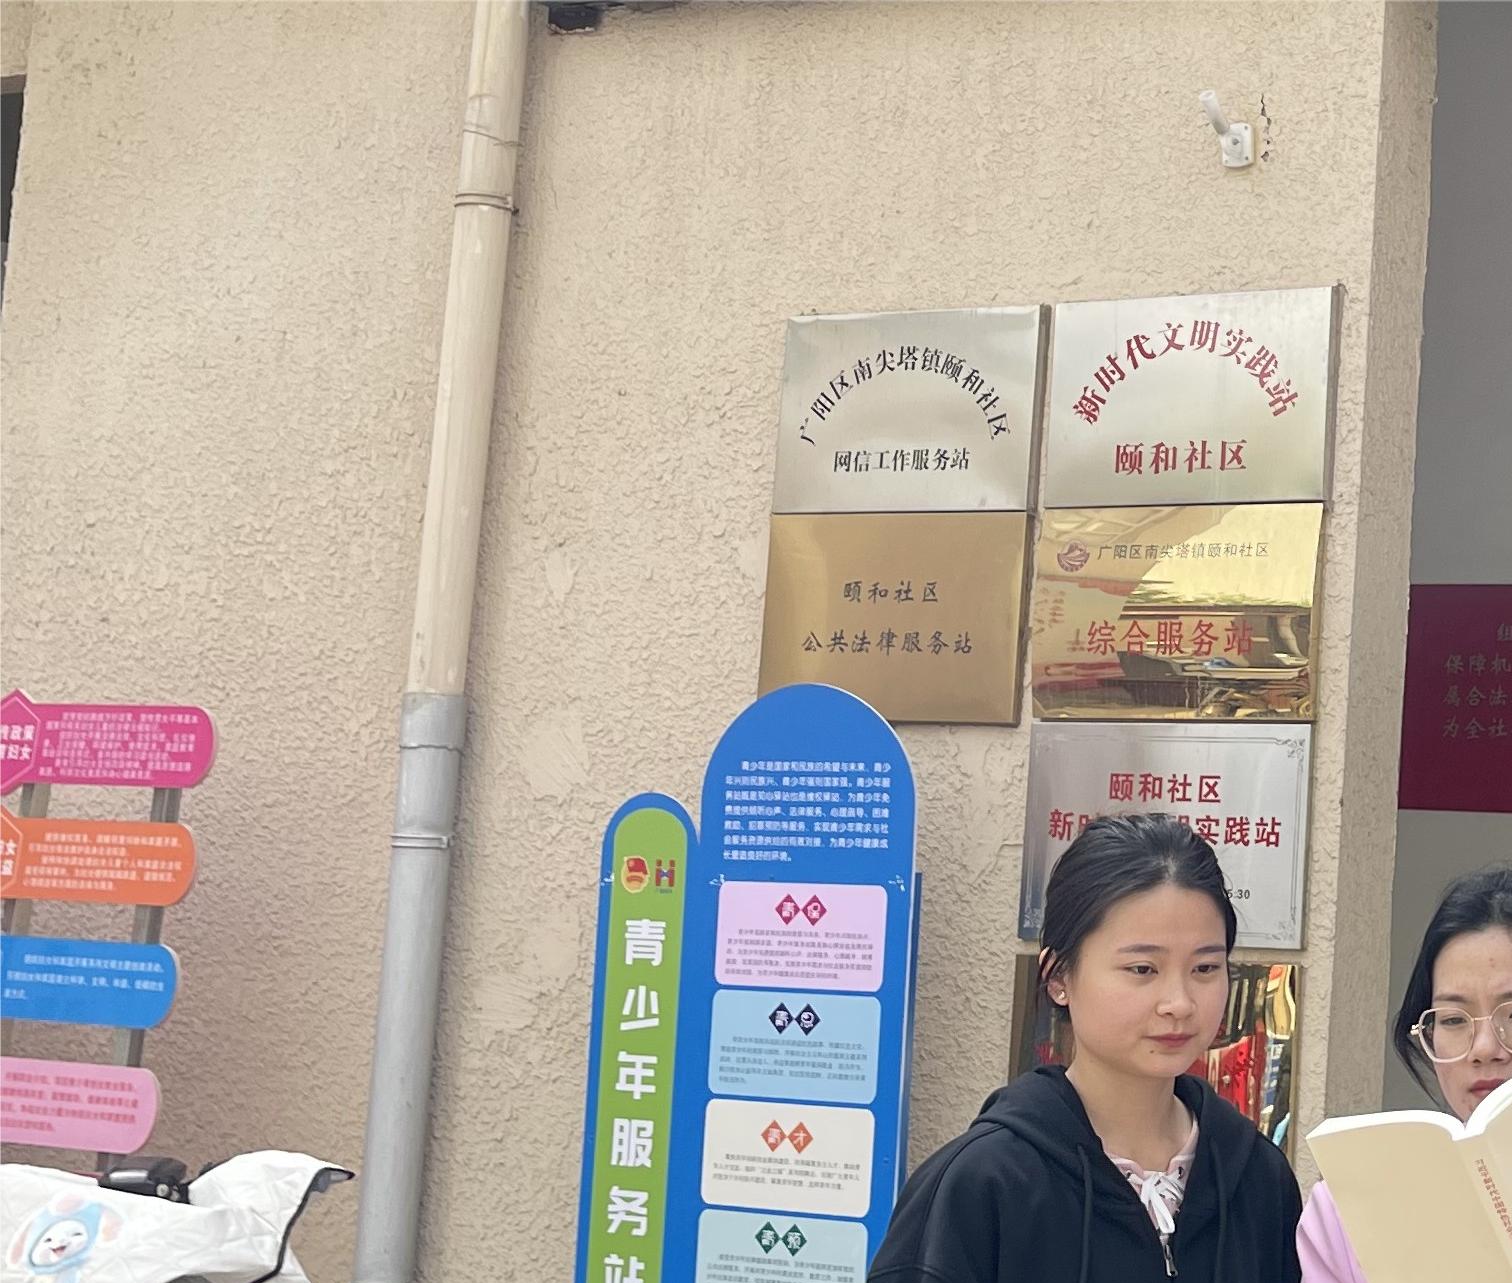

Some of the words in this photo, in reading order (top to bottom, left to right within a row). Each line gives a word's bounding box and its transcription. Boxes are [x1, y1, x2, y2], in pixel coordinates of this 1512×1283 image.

[1073, 319, 1299, 427] 新时代文明实践站
[799, 345, 1011, 447] 广阳区南尖塔镇颐和社区
[832, 447, 971, 474] 网信工作服务站
[1114, 439, 1248, 477] 颐和社区
[1096, 542, 1269, 562] 广阳区南尖塔镇颐和社区
[842, 579, 940, 605] 颐和社区
[801, 628, 975, 657] 公共法律服务站
[1086, 619, 1254, 658] 综合服务站
[1108, 772, 1223, 804] 颐和社区
